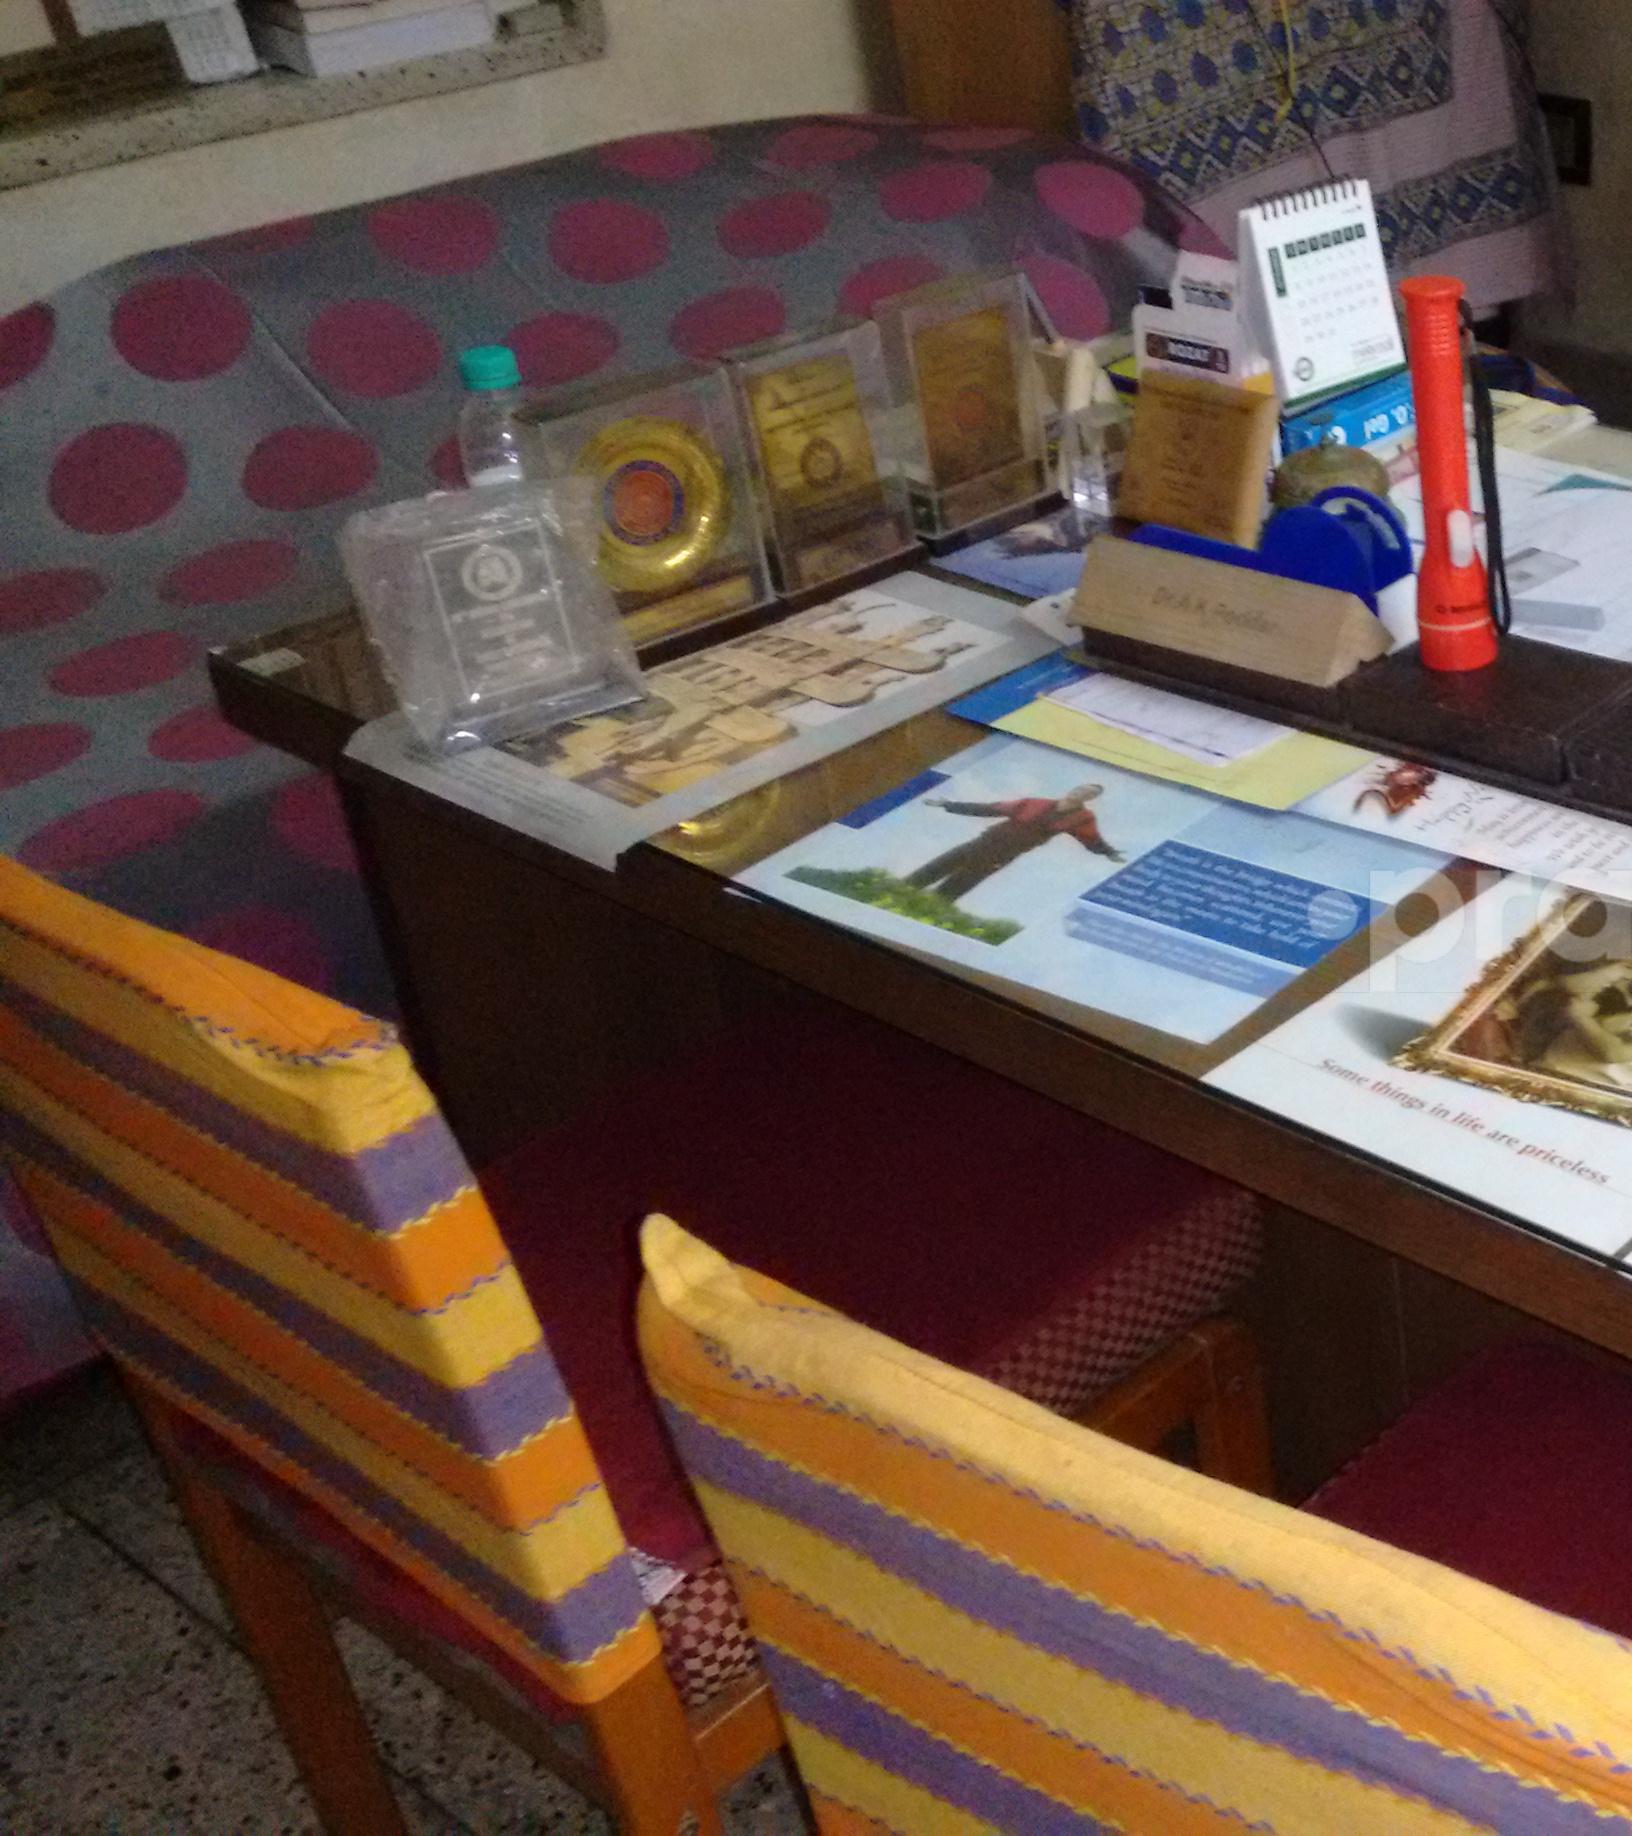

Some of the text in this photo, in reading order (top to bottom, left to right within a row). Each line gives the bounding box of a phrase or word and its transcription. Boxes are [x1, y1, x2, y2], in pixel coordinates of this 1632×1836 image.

[1318, 1057, 1612, 1185] Some things in life are priceless
